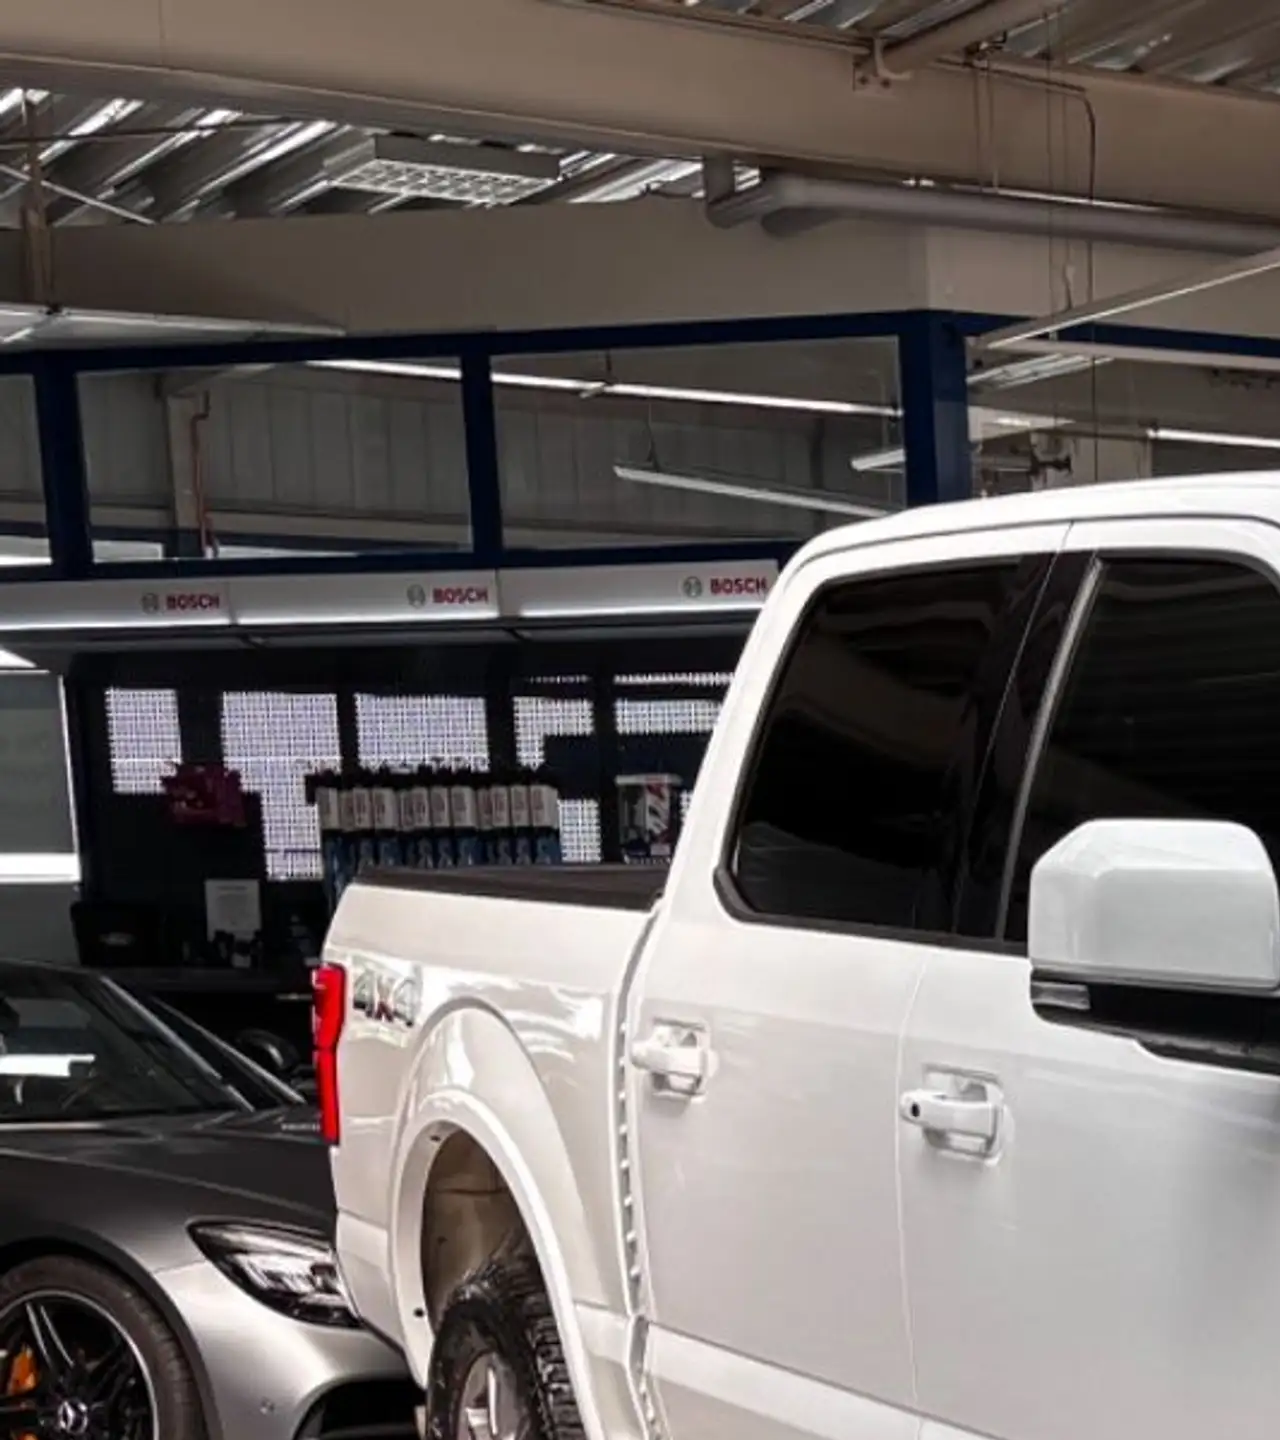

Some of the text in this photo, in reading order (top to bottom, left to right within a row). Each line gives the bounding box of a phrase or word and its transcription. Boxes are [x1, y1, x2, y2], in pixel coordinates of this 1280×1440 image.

[710, 577, 768, 595] BOSCH
[166, 593, 220, 611] BOSCH
[432, 587, 488, 604] BOSCH
